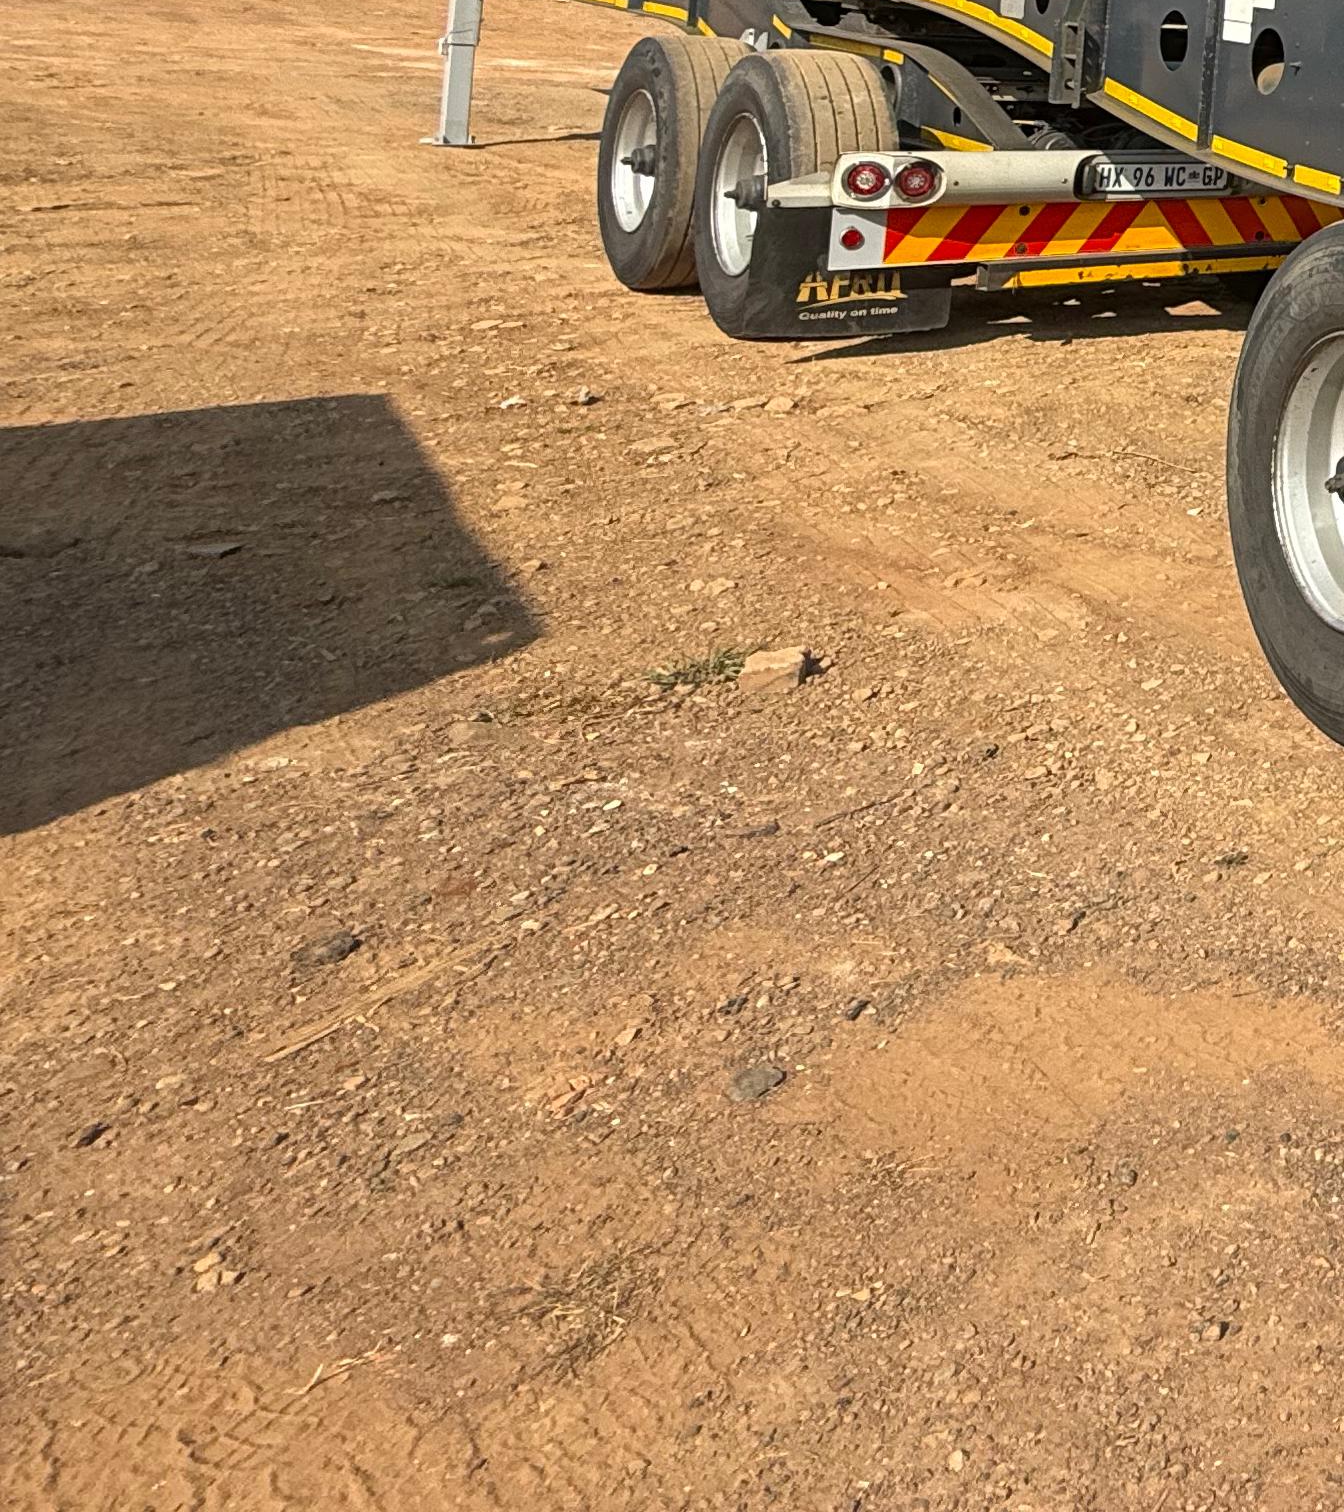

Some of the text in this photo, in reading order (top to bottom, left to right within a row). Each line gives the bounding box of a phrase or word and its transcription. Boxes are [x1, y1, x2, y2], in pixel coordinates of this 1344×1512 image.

[1098, 164, 1225, 188] HX 96 WC GP
[798, 306, 898, 321] Quality on time
